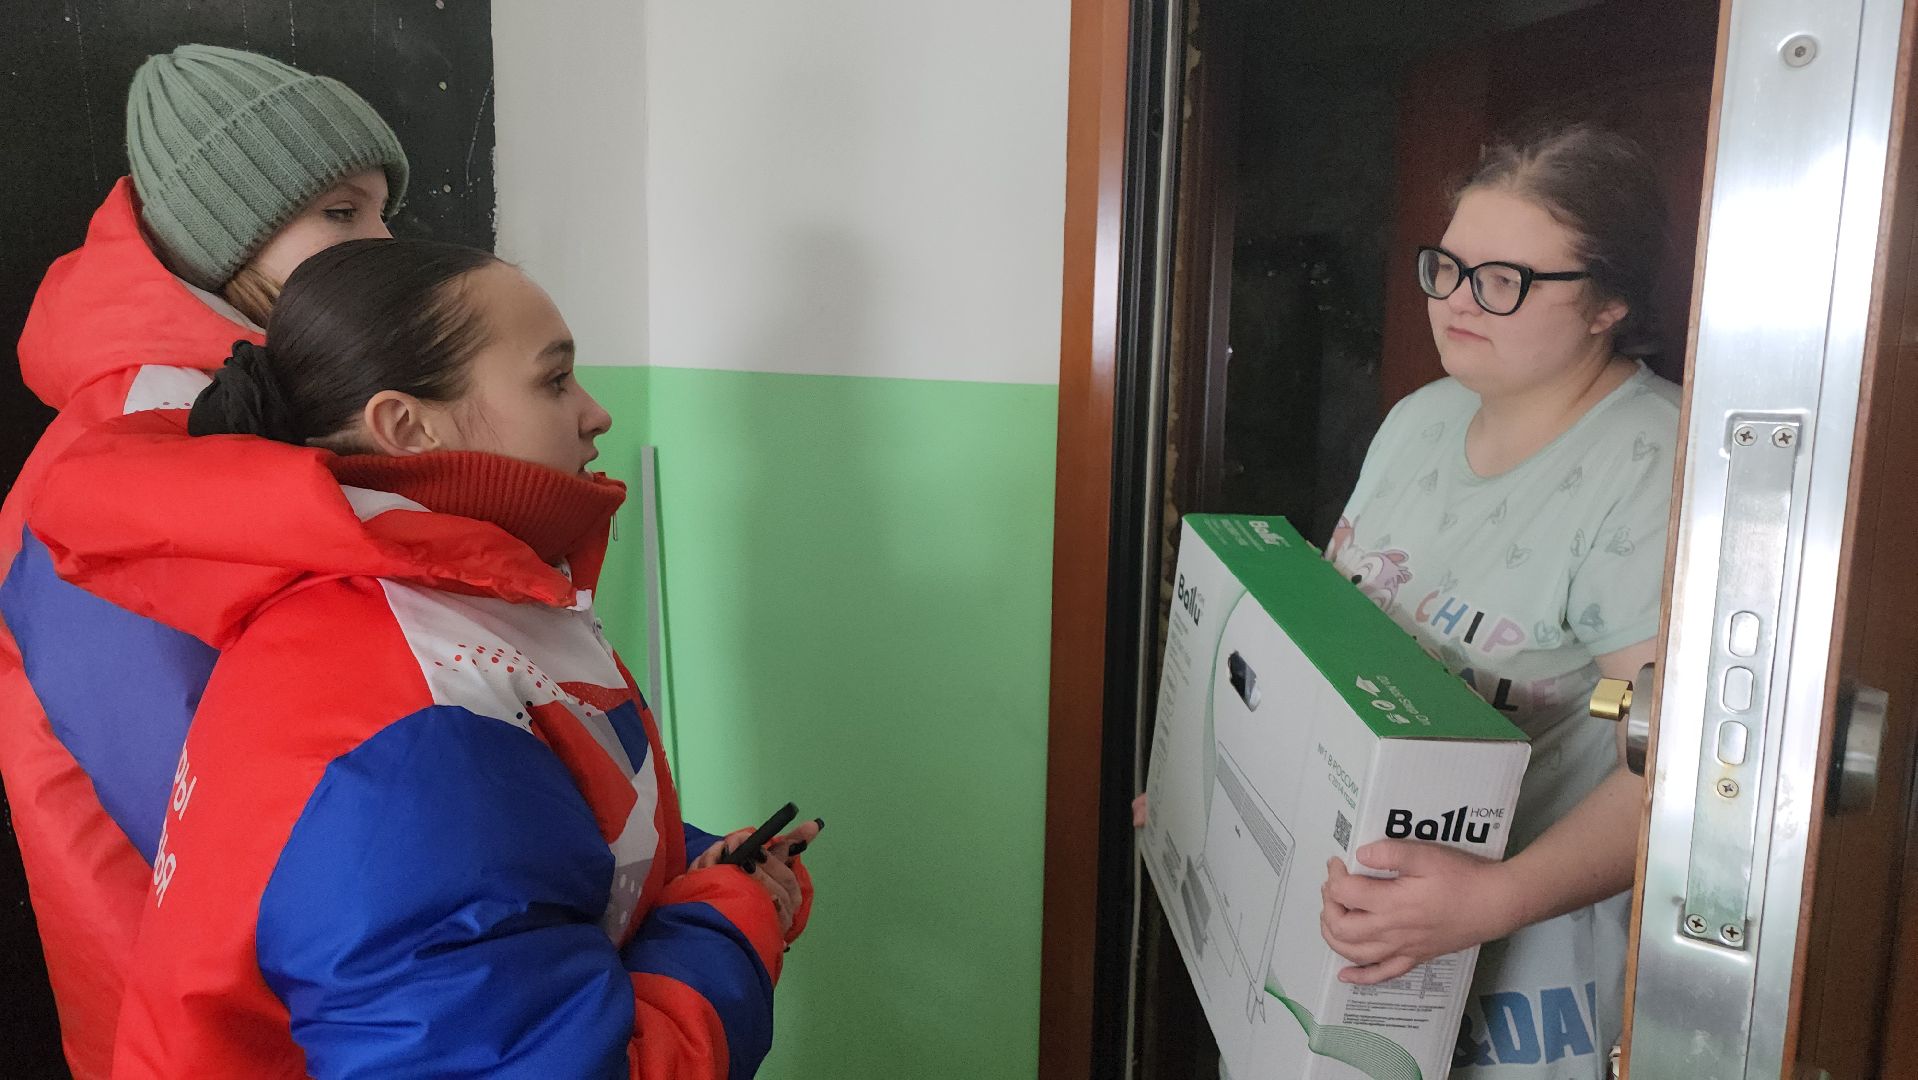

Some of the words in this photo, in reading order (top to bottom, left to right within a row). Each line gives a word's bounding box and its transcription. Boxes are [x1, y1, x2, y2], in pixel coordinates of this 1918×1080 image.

[1177, 573, 1201, 627] Ballu
[1415, 589, 1526, 653] CHIP
[1385, 805, 1491, 844] Ballu
[1470, 807, 1506, 819] HOME
